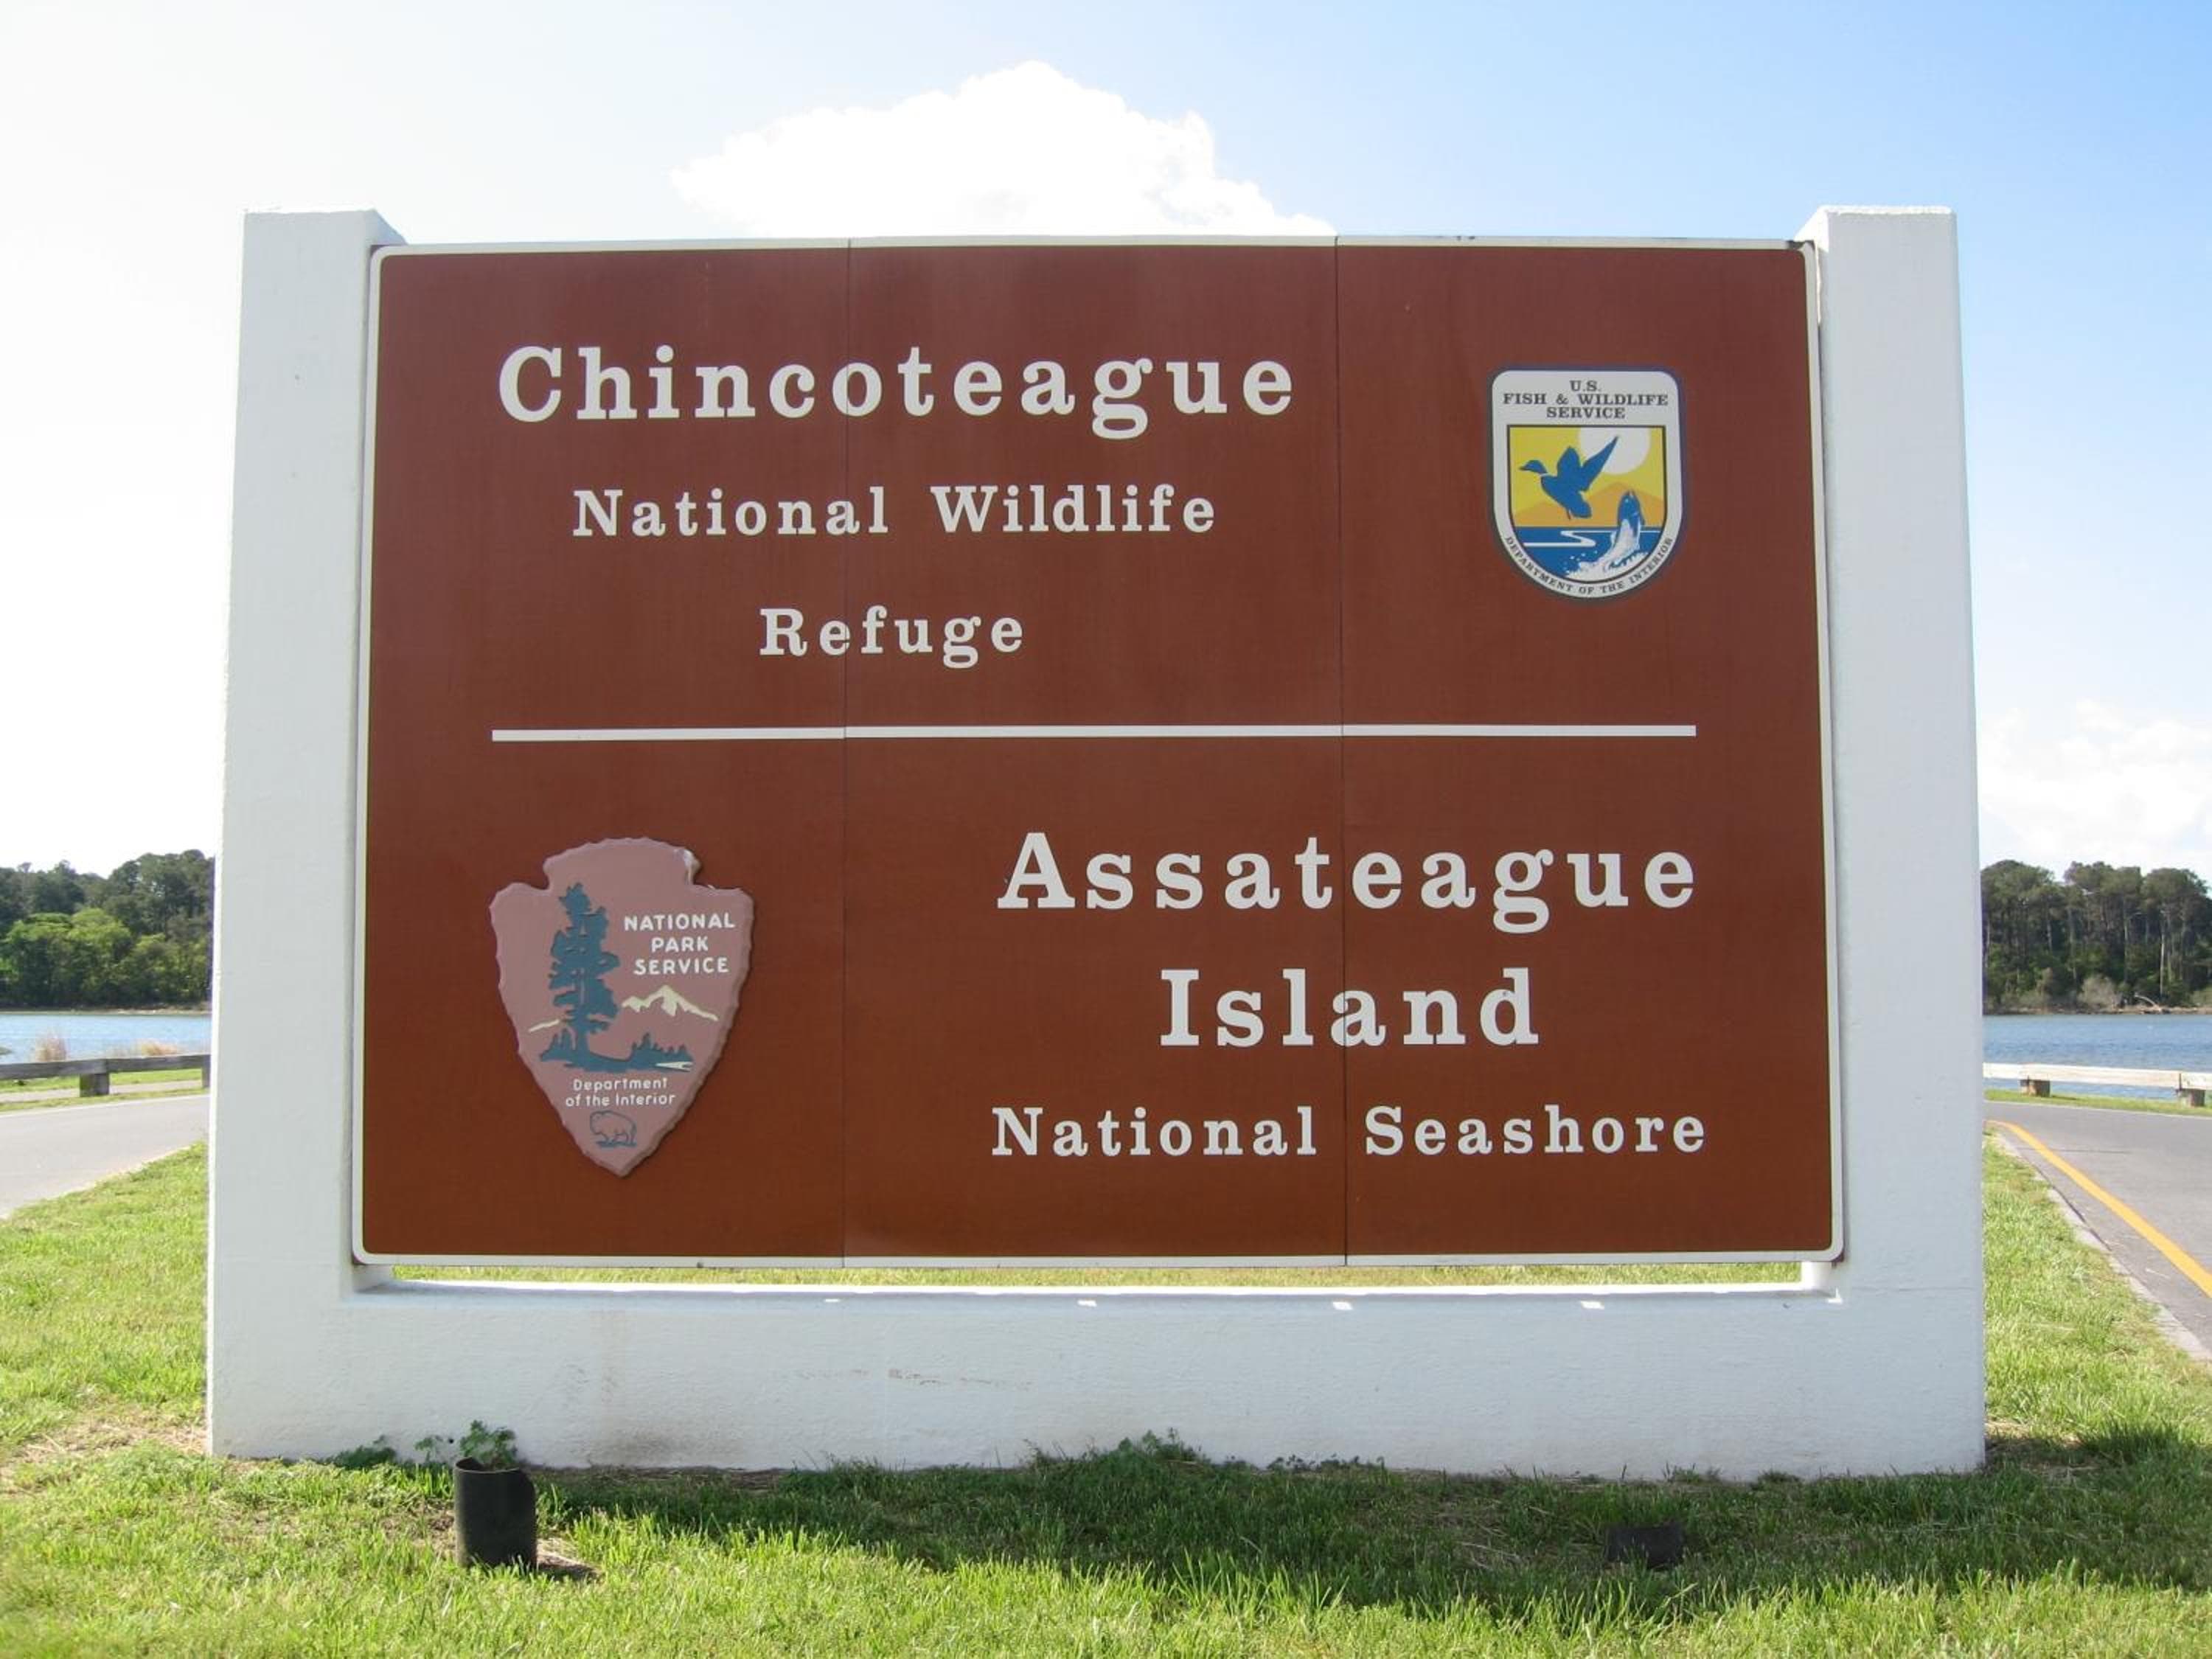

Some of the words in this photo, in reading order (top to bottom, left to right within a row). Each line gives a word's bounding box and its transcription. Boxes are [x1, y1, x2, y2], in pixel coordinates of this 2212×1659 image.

[498, 344, 1292, 439] Chincoteague
[1569, 380, 1601, 392] U.S.
[1503, 393, 1546, 405] FISH
[1555, 394, 1568, 405] &
[1578, 394, 1669, 406] WILDLIFE
[1546, 407, 1625, 419] SERVICE
[572, 486, 888, 538] National
[930, 483, 1214, 535] Wildlife
[1506, 536, 1572, 592] DEPARTMENT
[1579, 586, 1594, 594] OF
[1600, 582, 1625, 594] THE
[1629, 537, 1673, 583] INTERIOR
[759, 605, 1023, 669] Refuge
[997, 832, 1694, 933] Assateague
[623, 912, 735, 931] NATIONAL
[651, 936, 709, 953] PARK
[633, 958, 729, 975] SERVICE
[1161, 967, 1539, 1047] Island
[573, 1077, 668, 1093] Department
[566, 1093, 581, 1107] of
[586, 1093, 610, 1106] the
[616, 1093, 676, 1105] Interior
[992, 1106, 1317, 1157] National
[1365, 1105, 1704, 1155] Seashore
